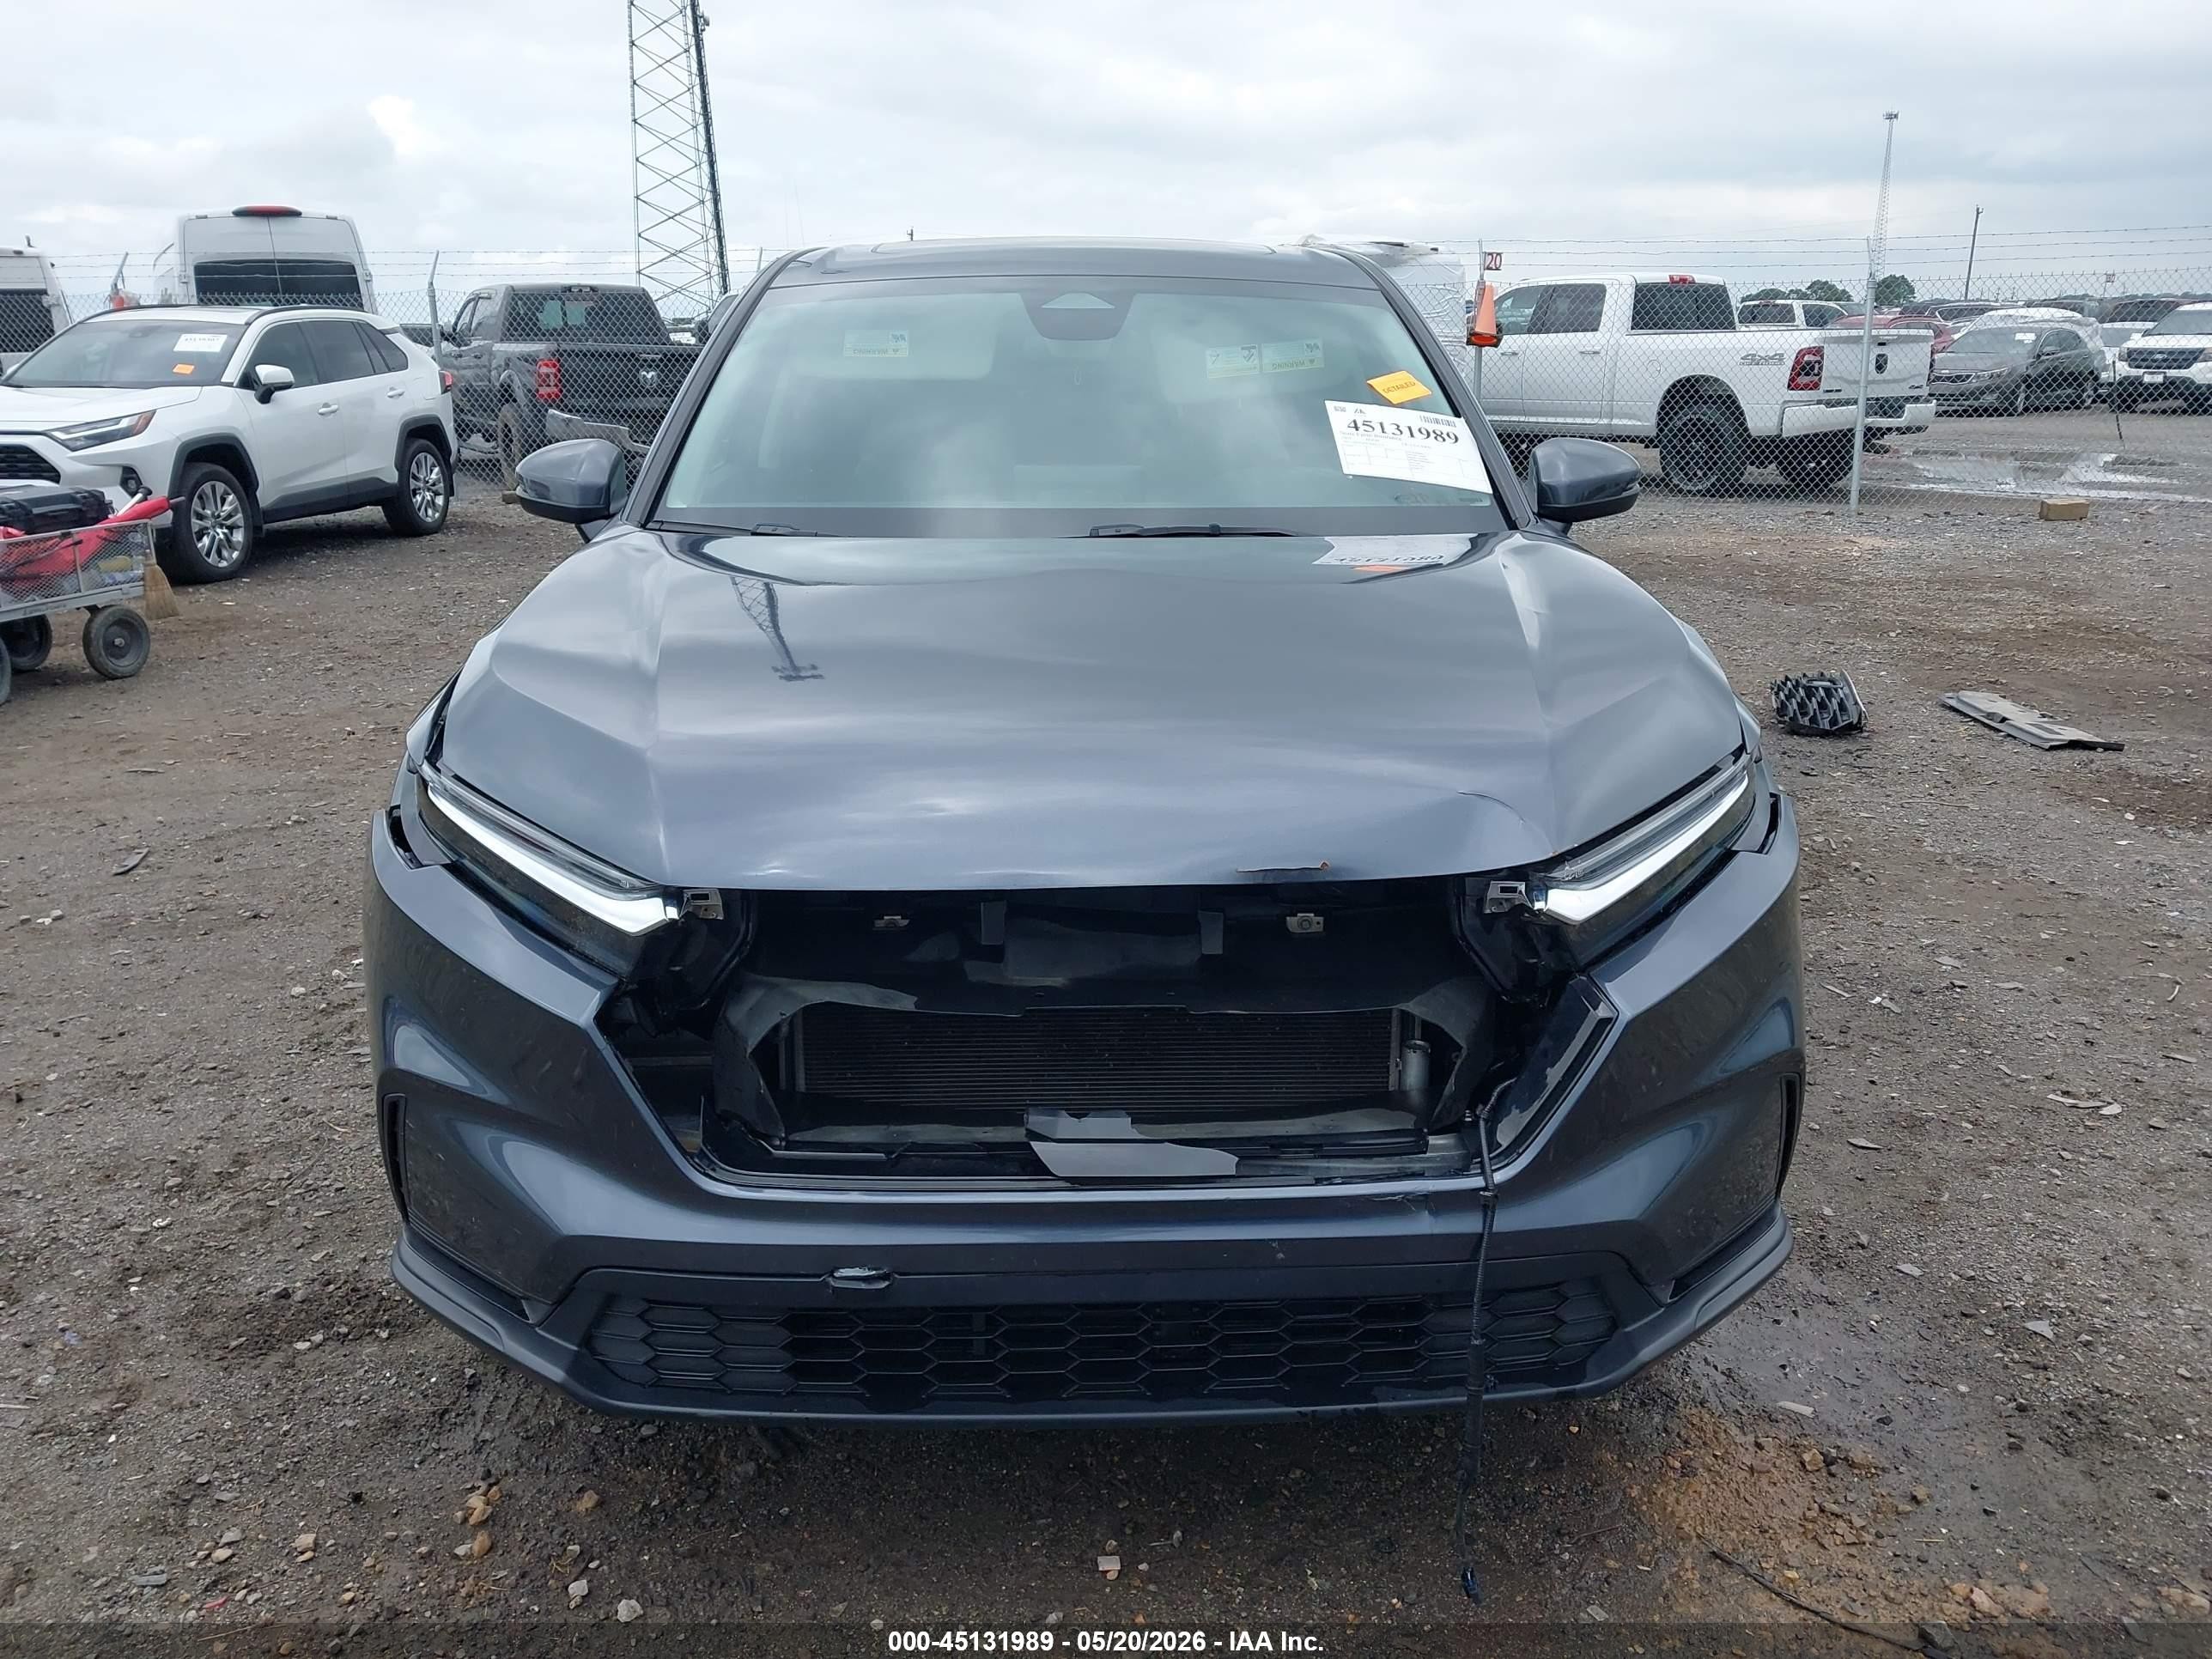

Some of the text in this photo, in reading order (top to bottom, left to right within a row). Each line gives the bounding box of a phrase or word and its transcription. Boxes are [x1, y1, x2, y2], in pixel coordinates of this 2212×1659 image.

[1486, 252, 1502, 270] 20
[1382, 380, 1417, 394] DETAILED
[1347, 418, 1460, 445] 45131989
